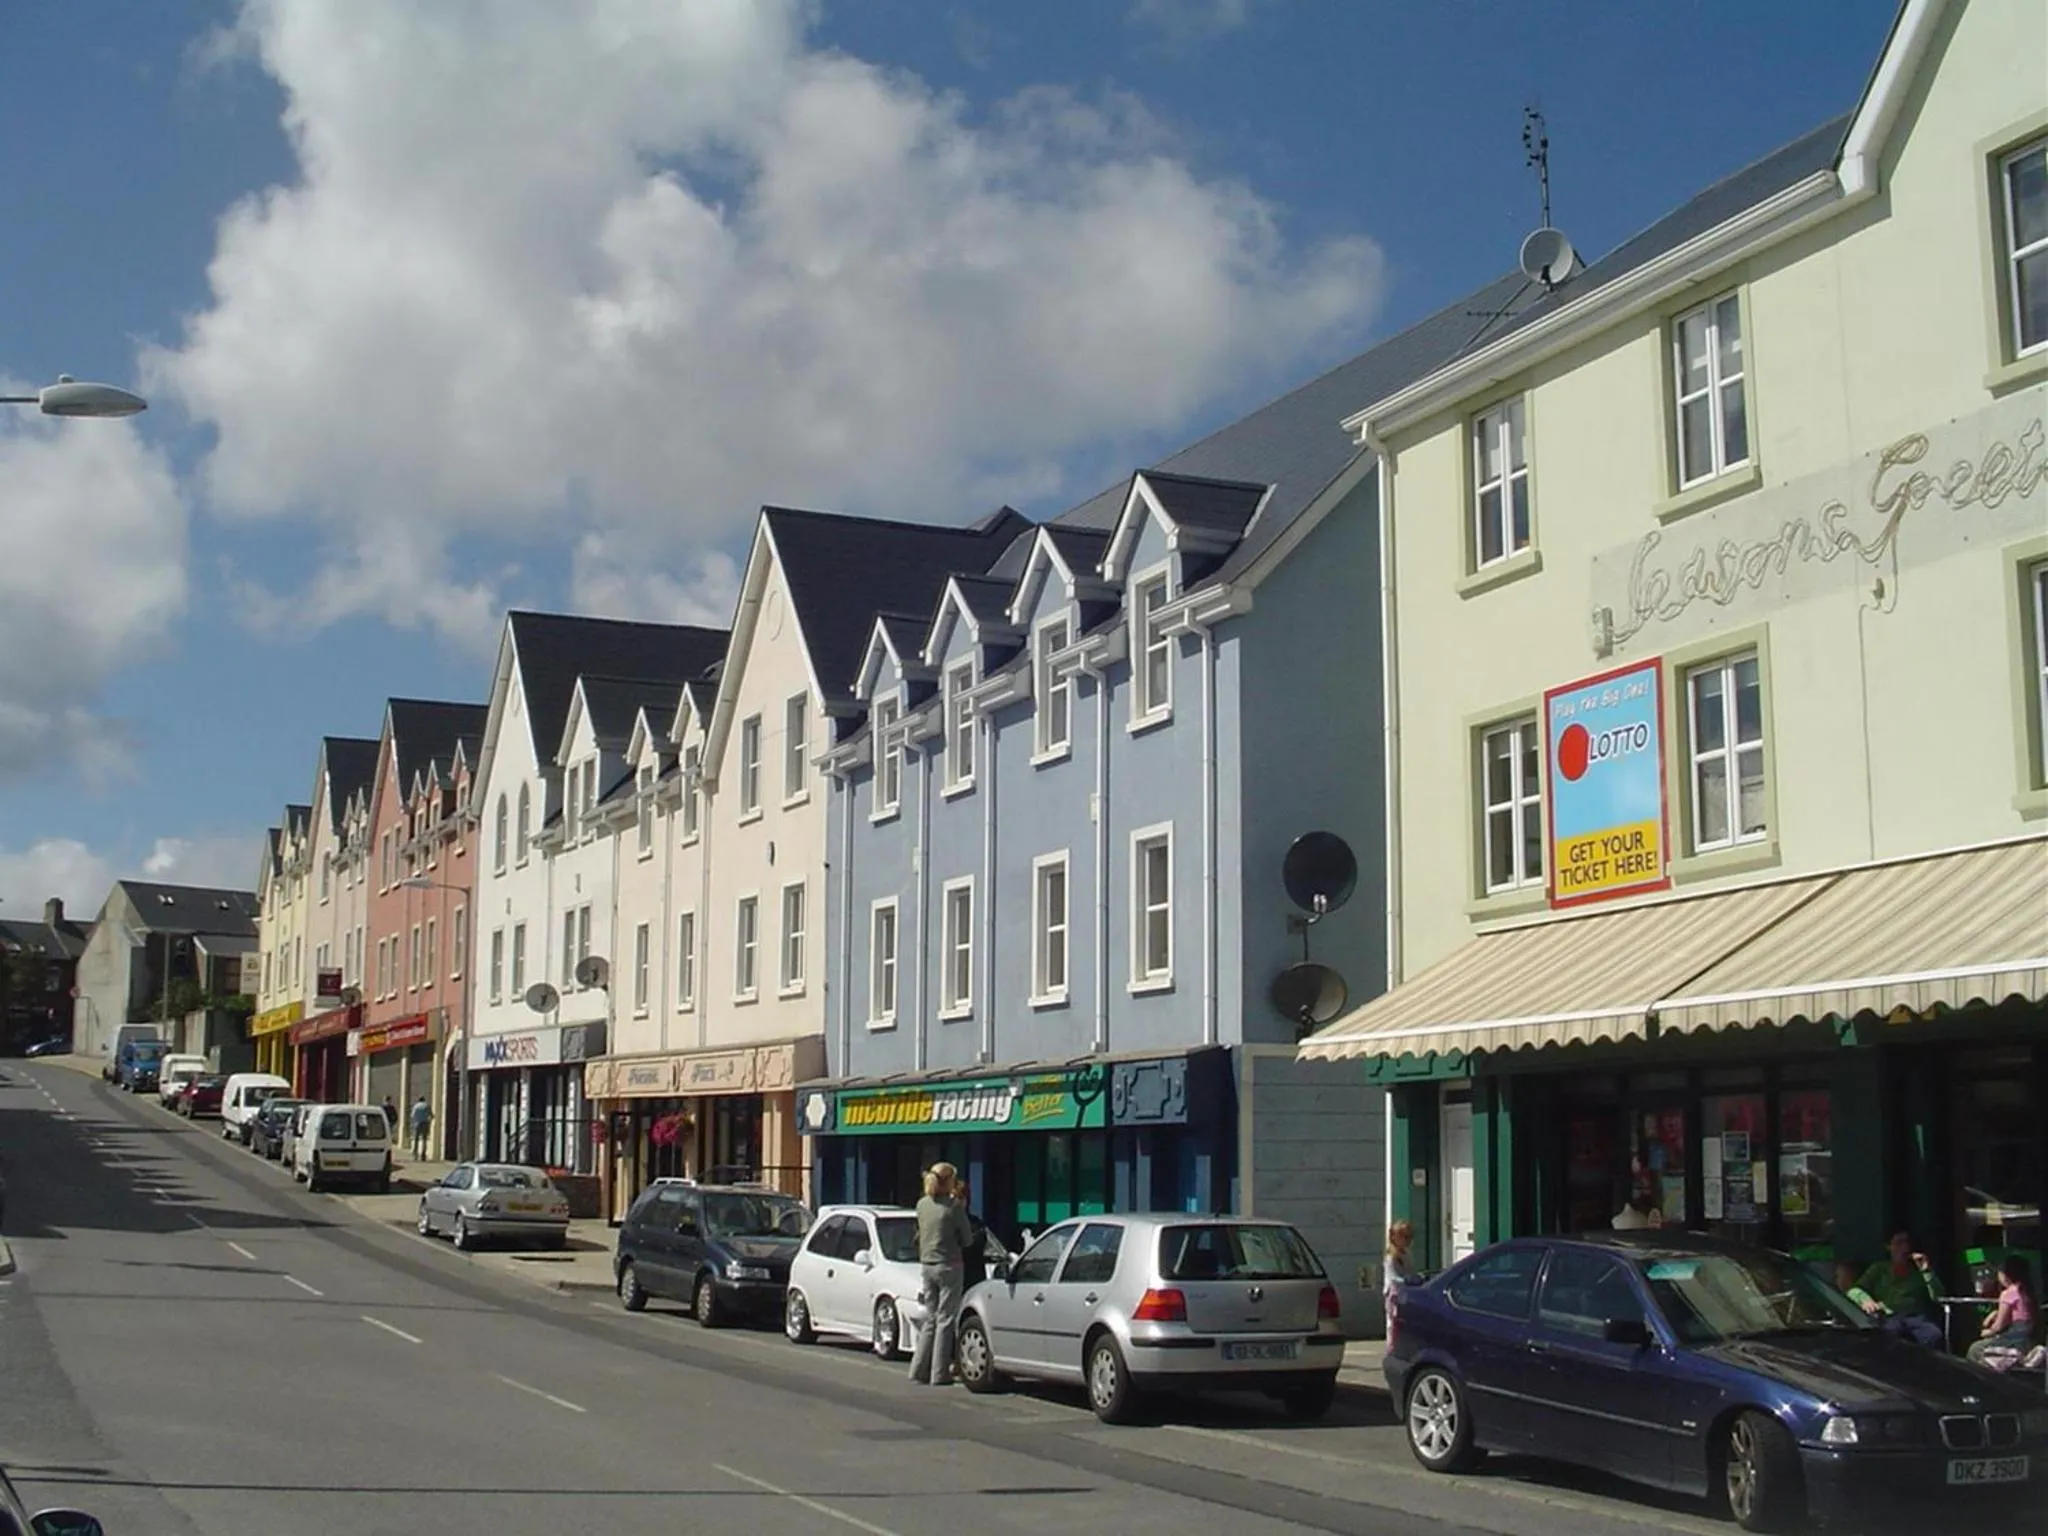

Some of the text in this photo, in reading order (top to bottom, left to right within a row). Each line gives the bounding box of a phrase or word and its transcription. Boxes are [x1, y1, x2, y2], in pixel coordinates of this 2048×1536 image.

[1589, 723, 1648, 761] LOTTO
[1569, 831, 1645, 863] GET YOUR
[1560, 850, 1658, 887] TICKET HERE!
[1954, 1460, 1986, 1480] DKZ
